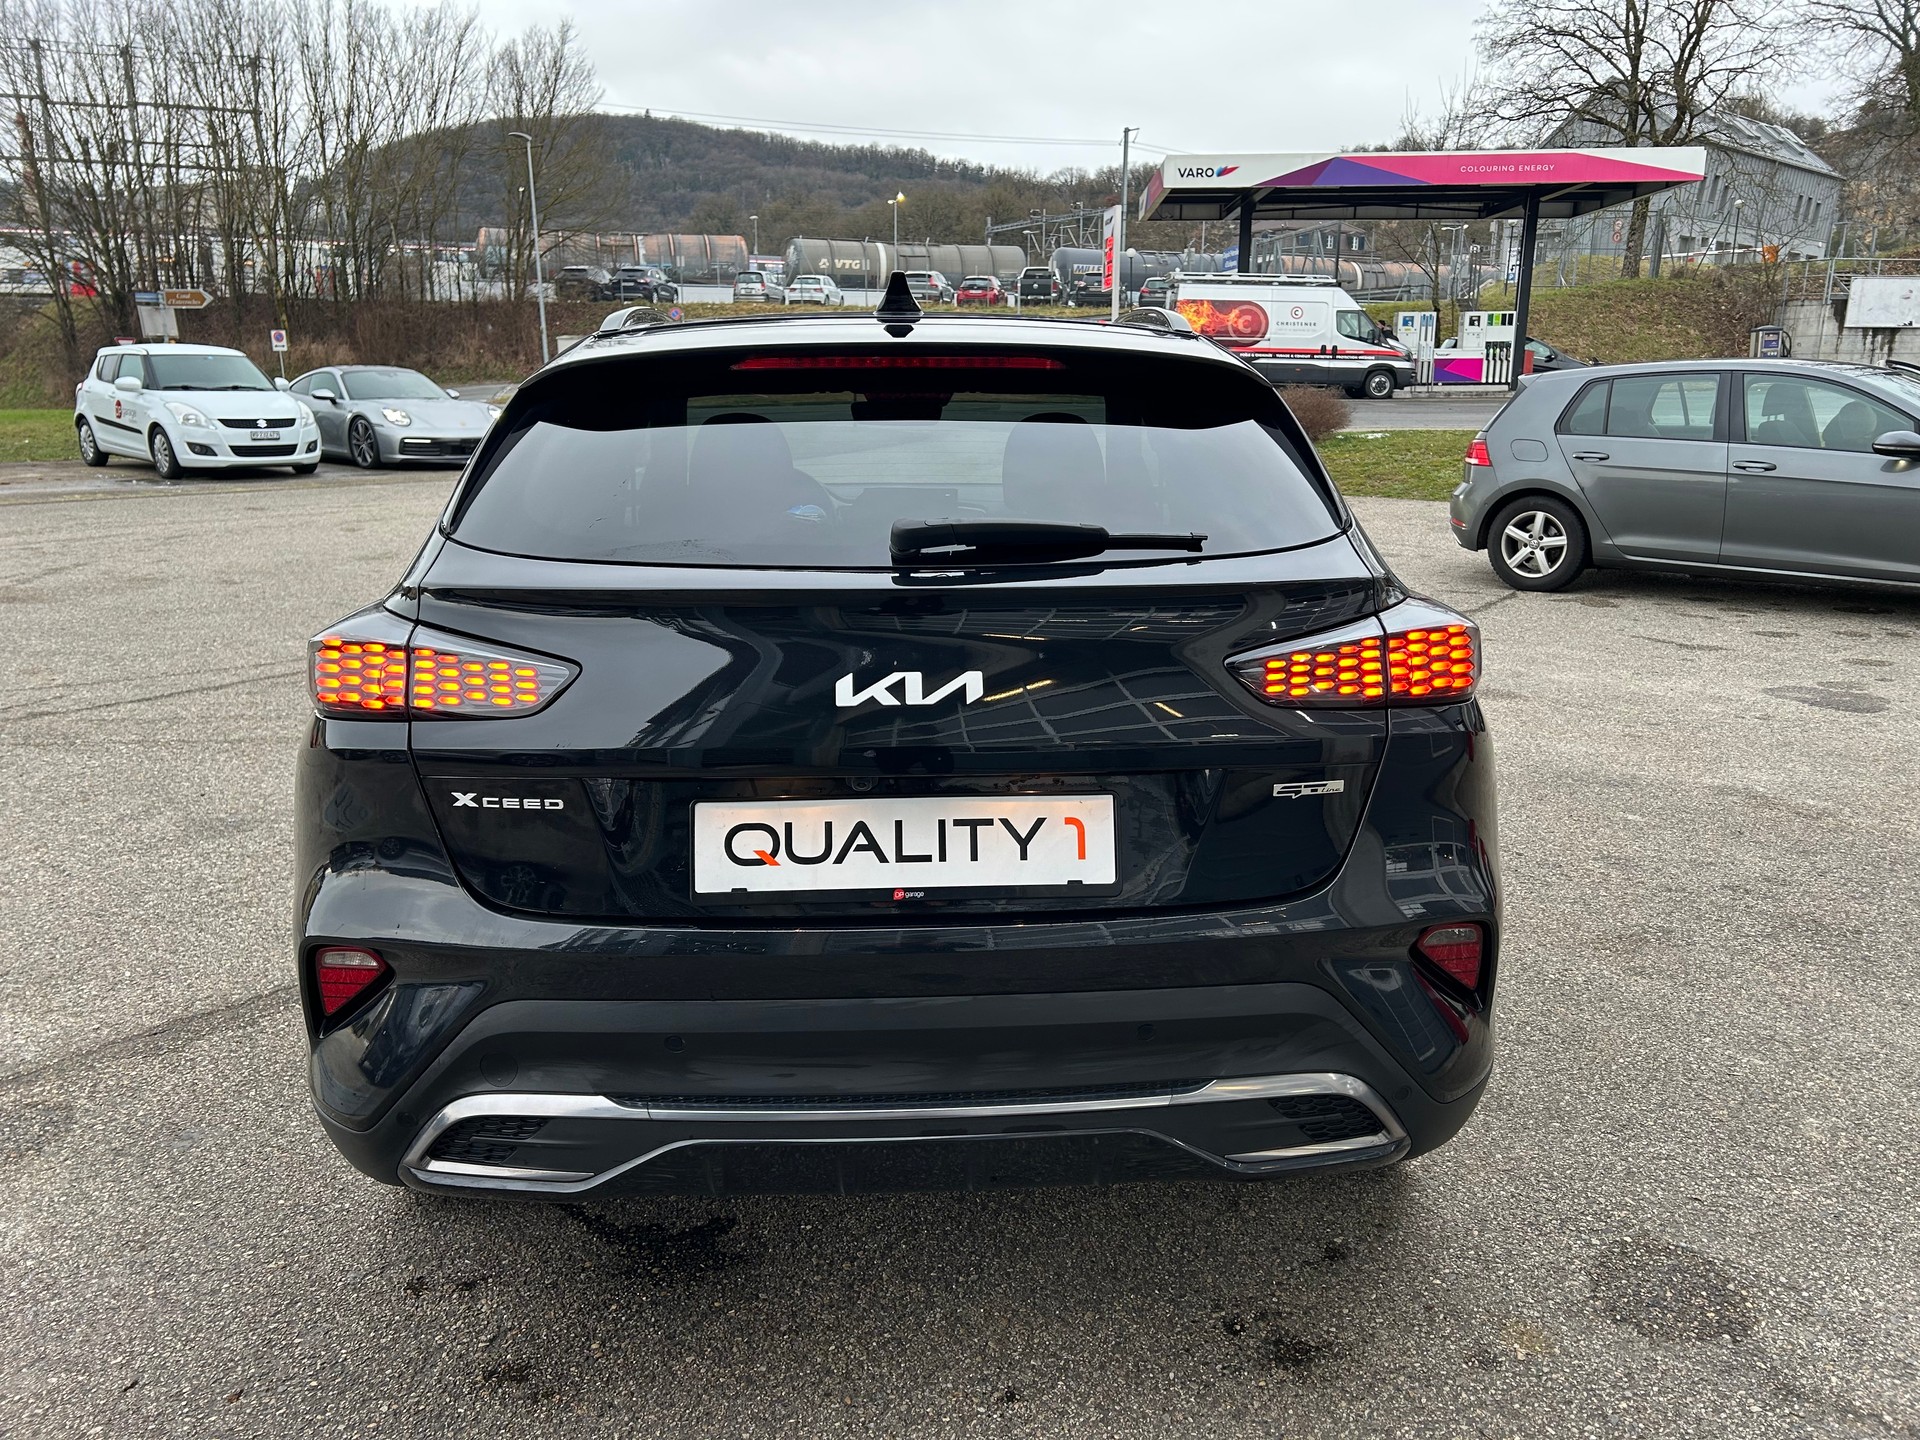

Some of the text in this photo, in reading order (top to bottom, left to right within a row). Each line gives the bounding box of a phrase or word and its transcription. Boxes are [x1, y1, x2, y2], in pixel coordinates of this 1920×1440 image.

[1178, 167, 1215, 178] VARO
[1460, 164, 1555, 173] COLOURING ENERGY
[834, 259, 861, 270] VTG
[724, 817, 1086, 867] QUALITY 1
